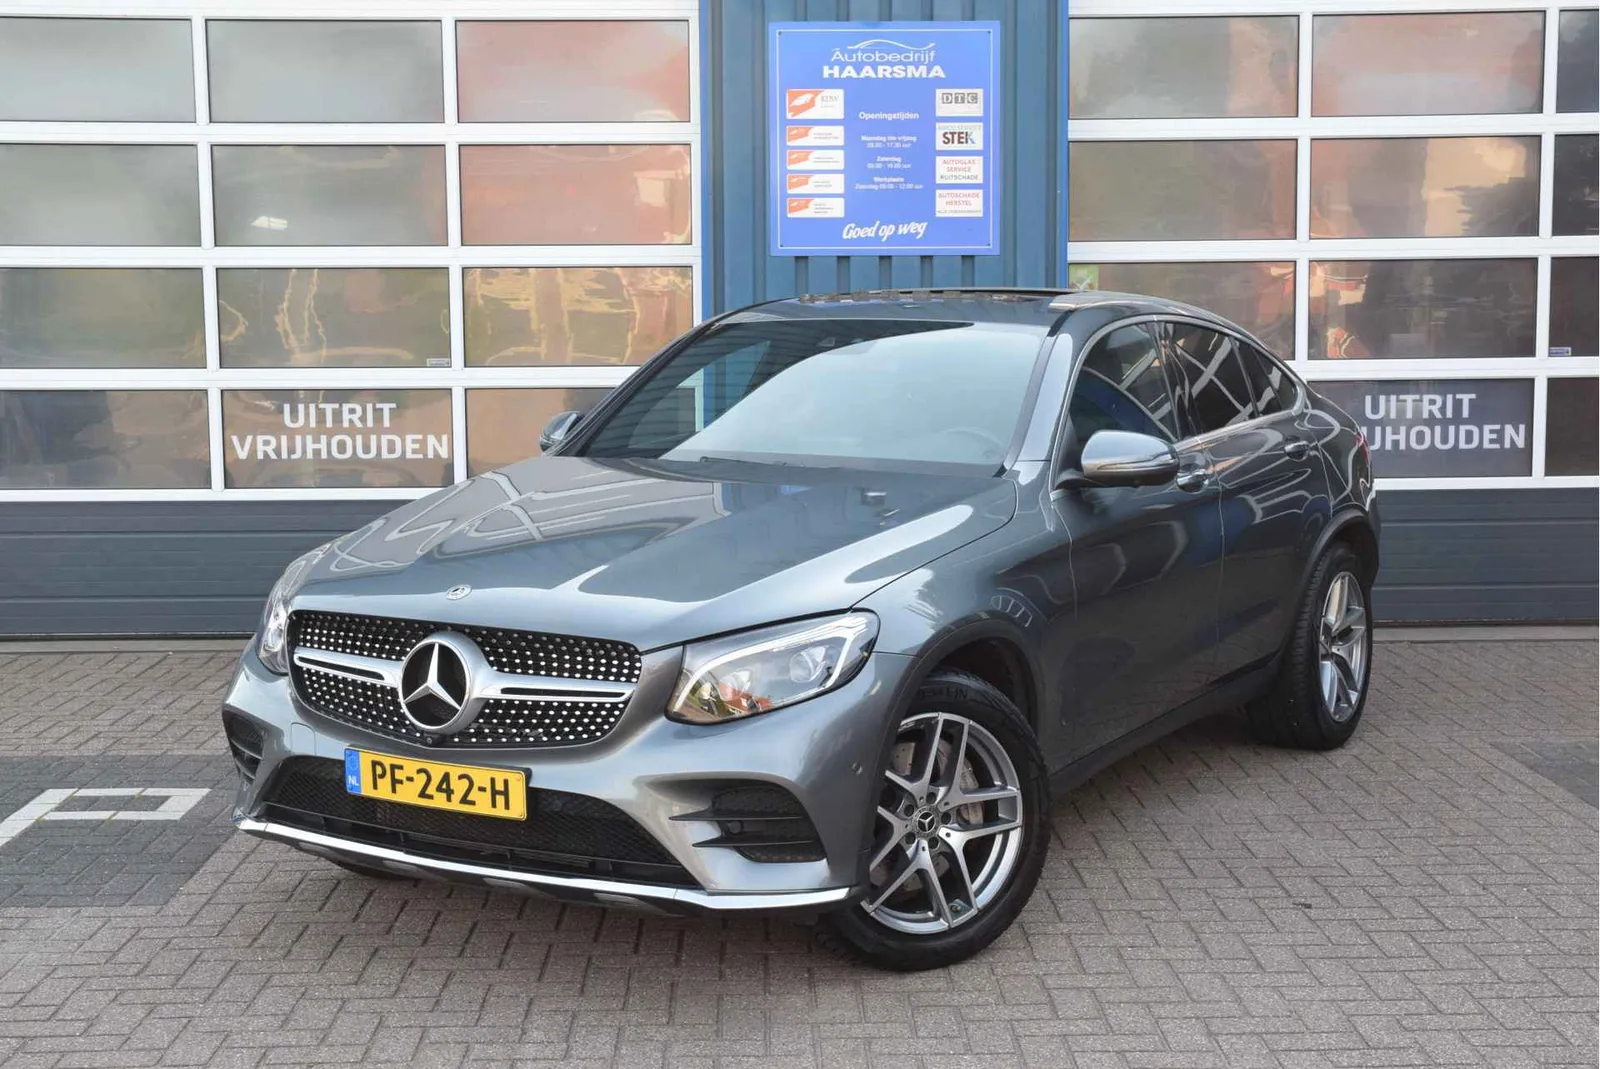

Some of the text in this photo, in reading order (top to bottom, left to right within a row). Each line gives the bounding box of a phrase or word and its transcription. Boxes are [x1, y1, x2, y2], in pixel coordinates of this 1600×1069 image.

[831, 49, 936, 64] Autobedrijf
[823, 65, 946, 78] HAARSMA
[942, 93, 978, 104] DTC
[859, 111, 920, 120] Openingstijden
[942, 131, 976, 144] STEK
[842, 220, 928, 242] Goed op weg
[1364, 393, 1476, 419] UITRIT
[283, 403, 396, 428] UITRIT
[231, 434, 448, 460] VRIJHOUDEN
[348, 775, 360, 786] NL
[371, 759, 510, 811] PF-242-H
